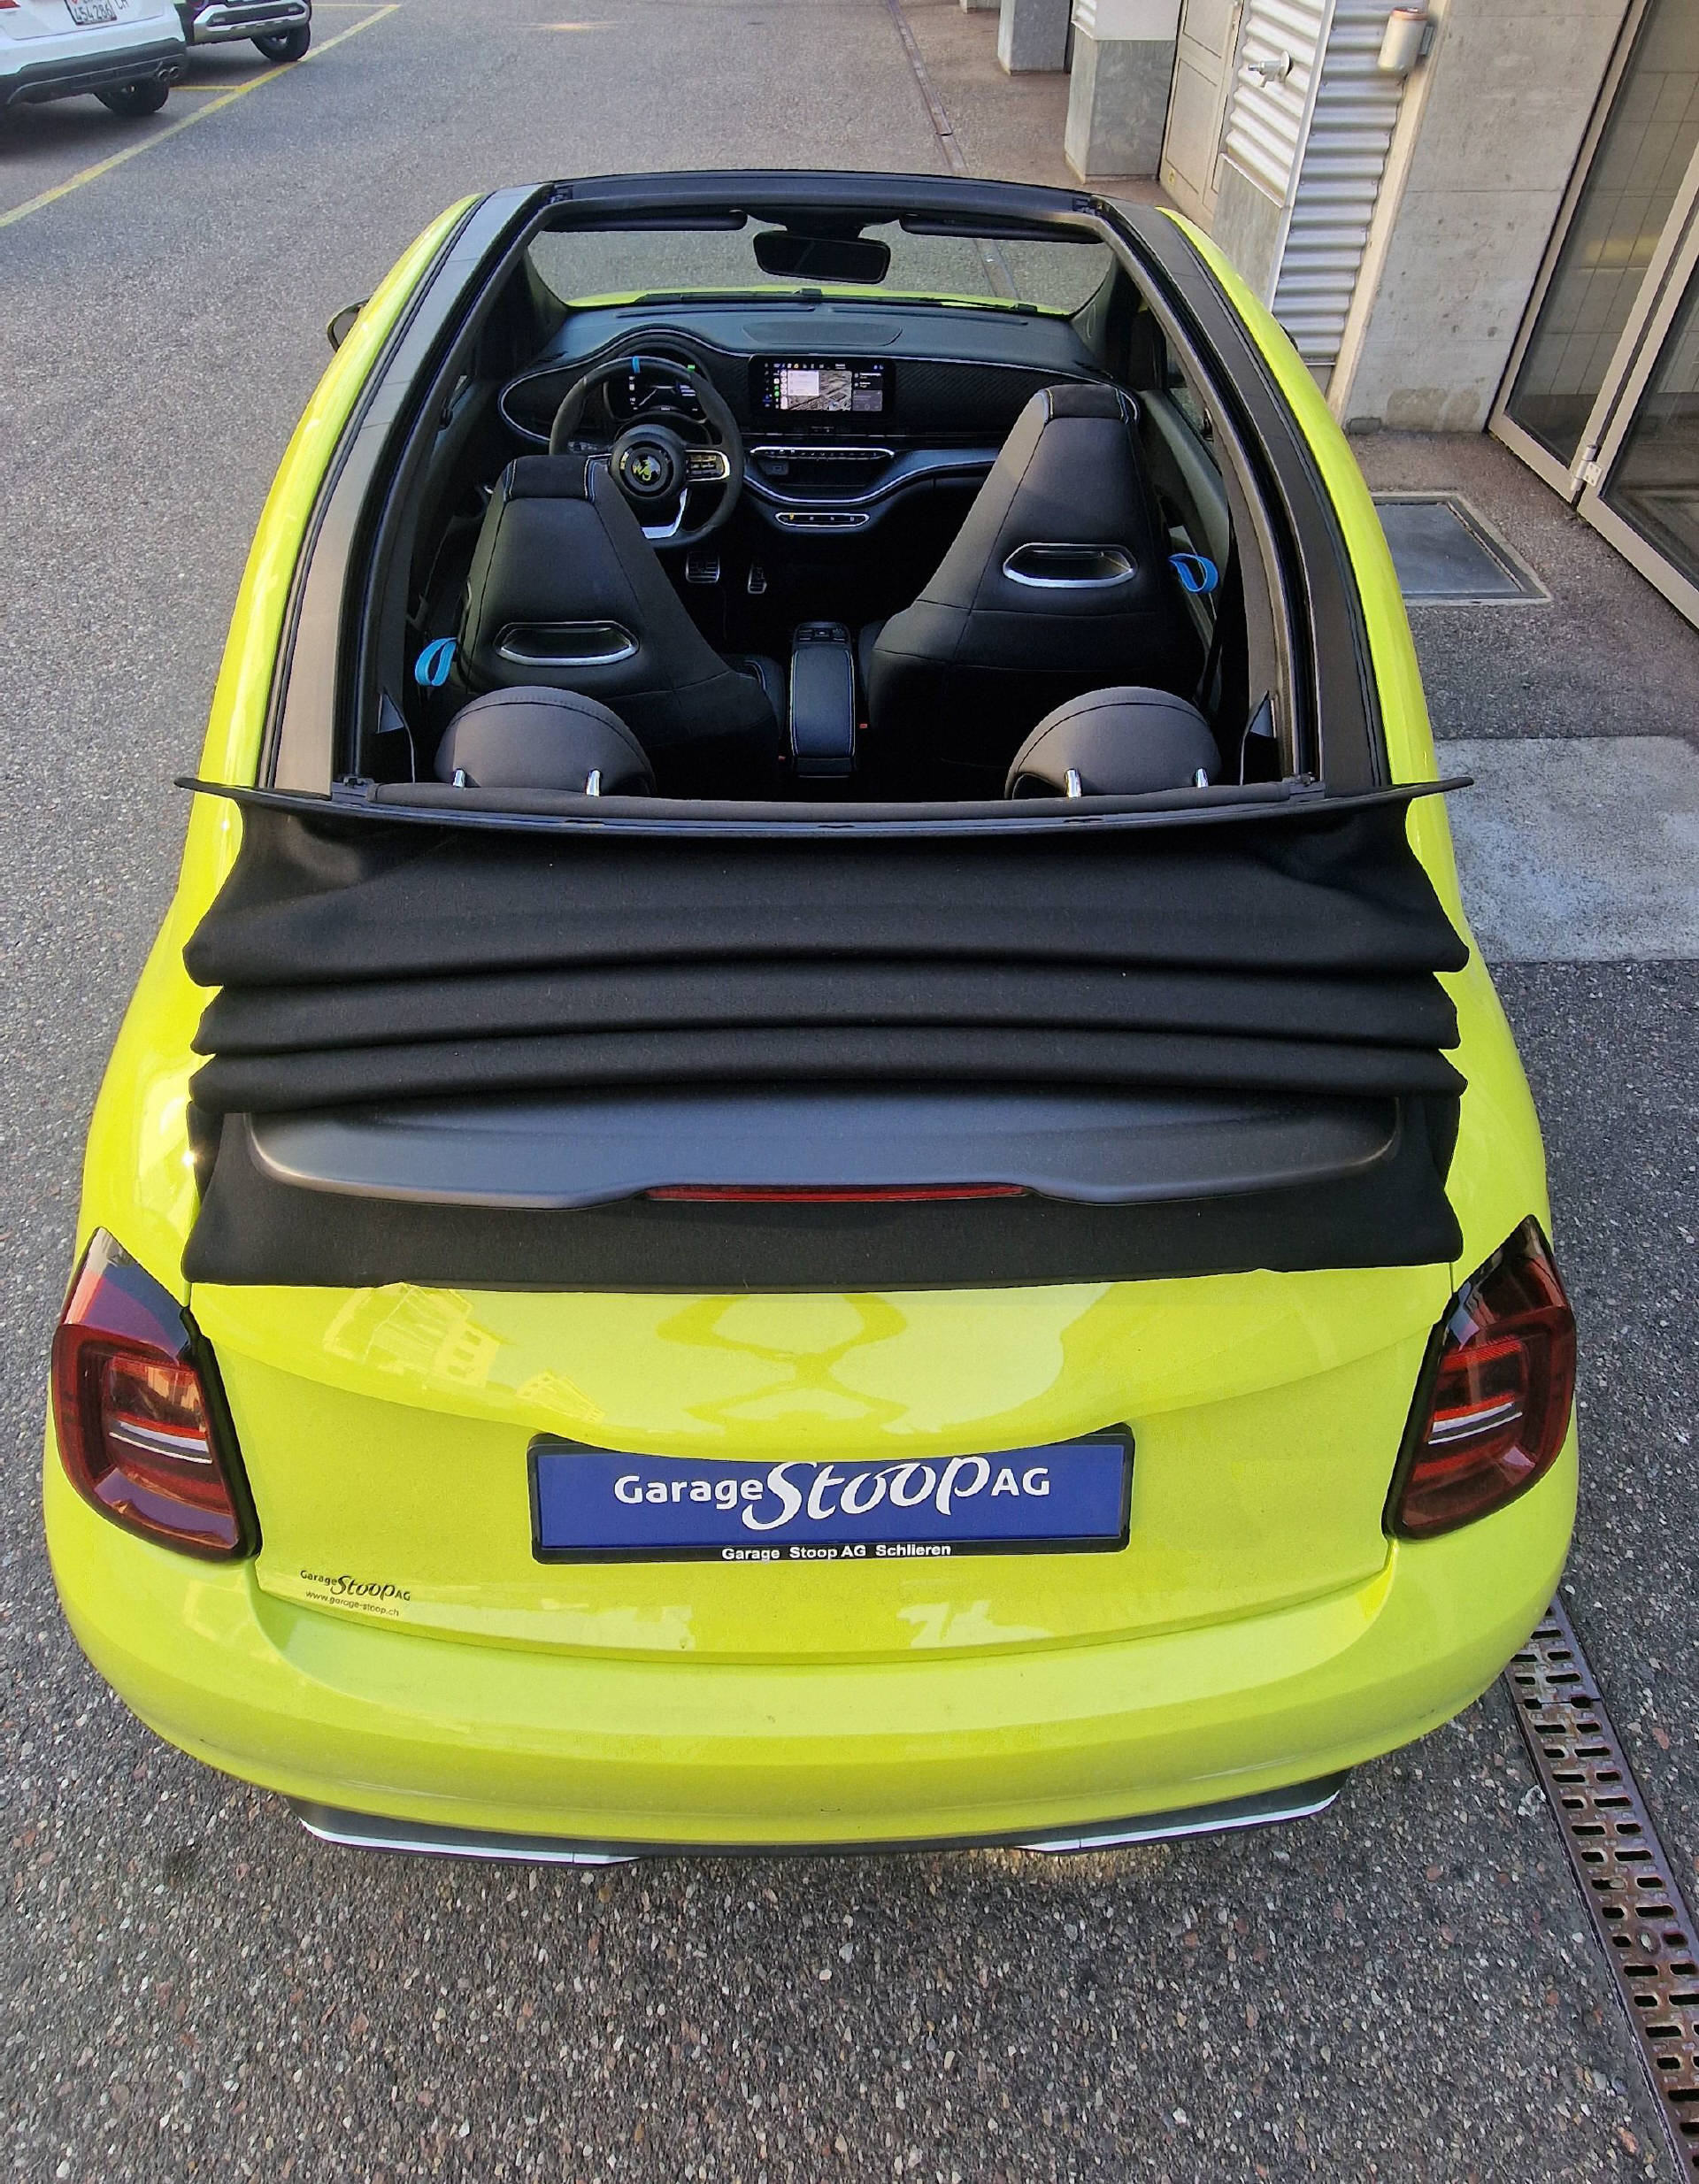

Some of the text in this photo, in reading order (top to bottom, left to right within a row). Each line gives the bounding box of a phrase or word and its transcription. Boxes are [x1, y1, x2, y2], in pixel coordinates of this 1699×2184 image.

[613, 1457, 1051, 1531] Garage Stoop AG
[721, 1543, 951, 1561] Garage Stoop AG Schlieren
[300, 1570, 411, 1602] Garage Stoop AG
[305, 1590, 400, 1617] www.garage-stoop.ch
